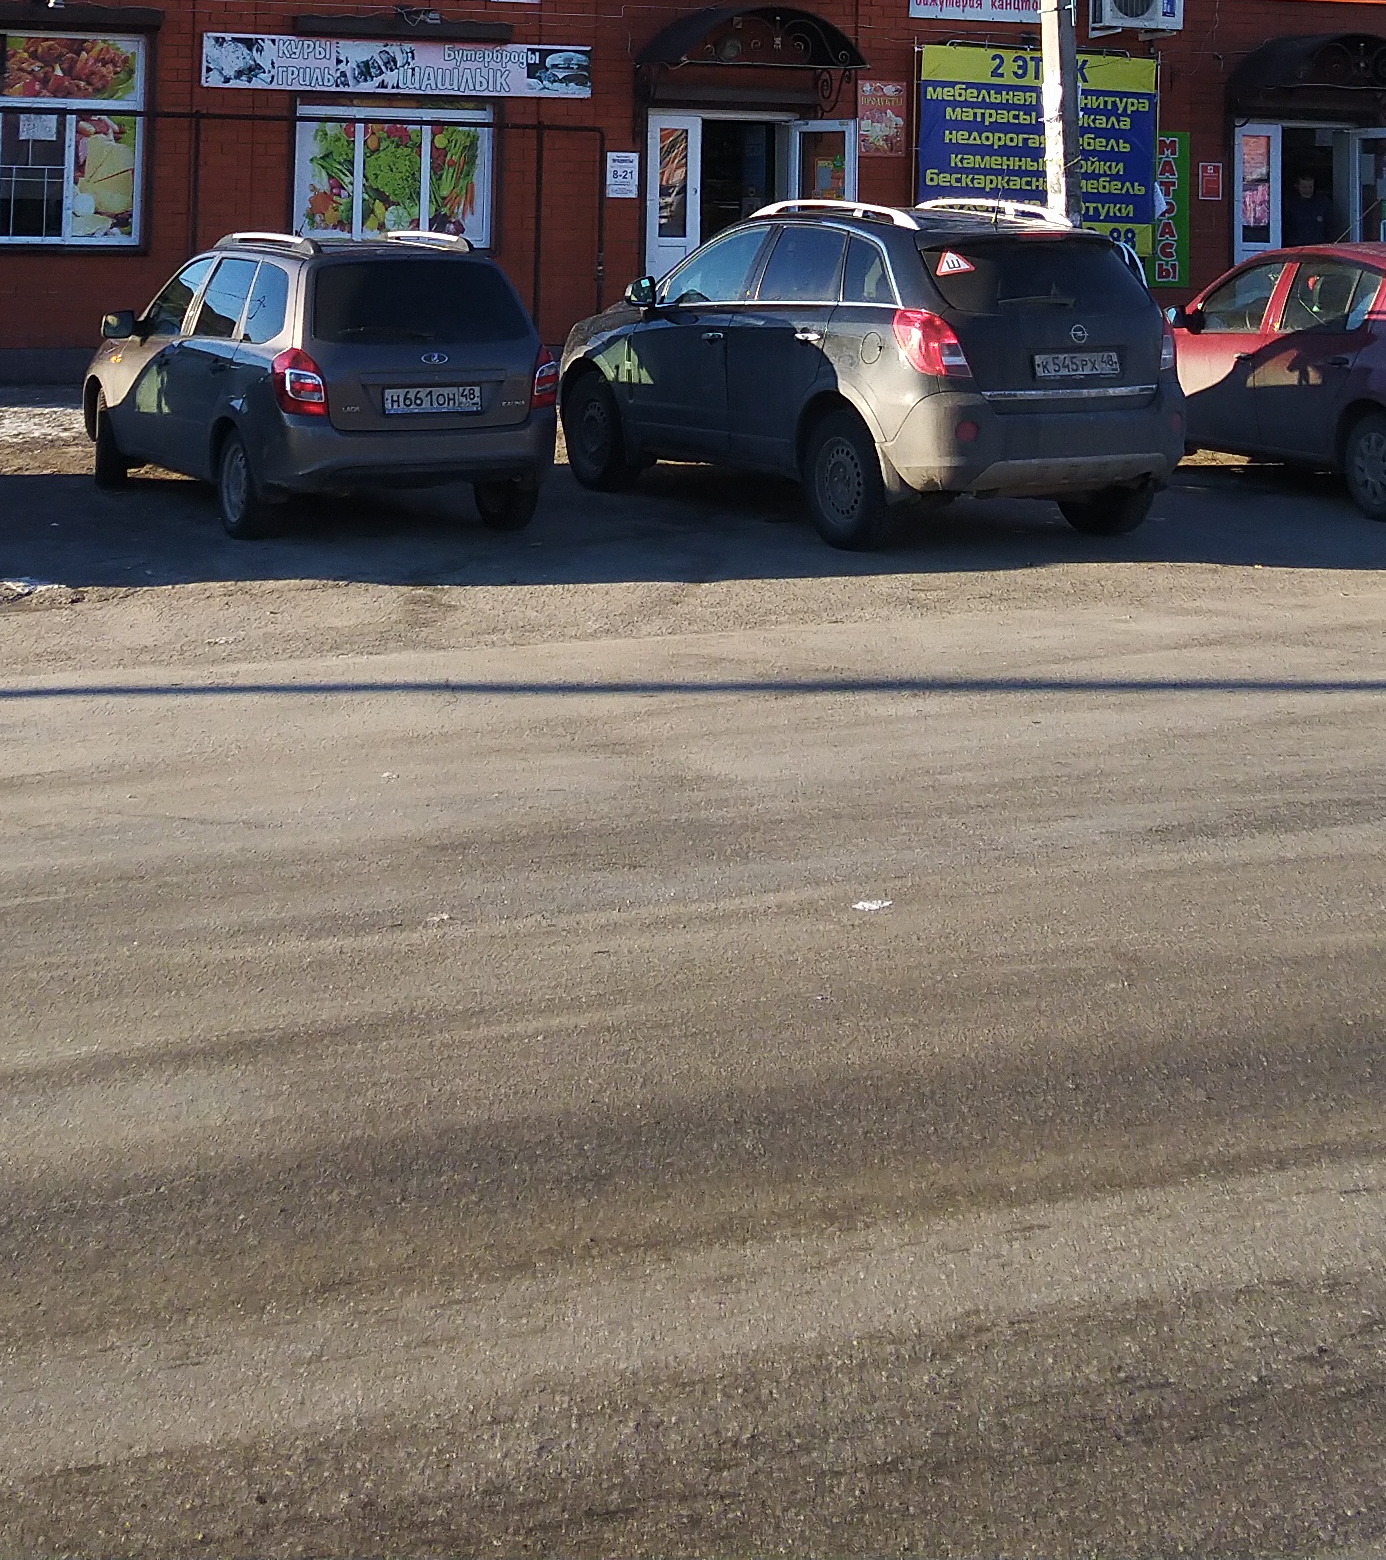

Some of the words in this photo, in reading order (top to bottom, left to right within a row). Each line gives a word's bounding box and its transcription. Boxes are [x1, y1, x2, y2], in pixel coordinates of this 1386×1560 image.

[277, 40, 333, 62] КУРЫ
[443, 46, 541, 70] Бутерброды
[276, 65, 336, 88] ГРИЛЬ
[991, 54, 1005, 78] 2
[399, 68, 511, 93] ШАШЛЫК
[926, 85, 1037, 105] мебельная
[945, 107, 1037, 125] матрасы
[950, 154, 1047, 171] каменны
[612, 169, 634, 180] 8-21
[1156, 137, 1180, 281] МАТРАСЫ
